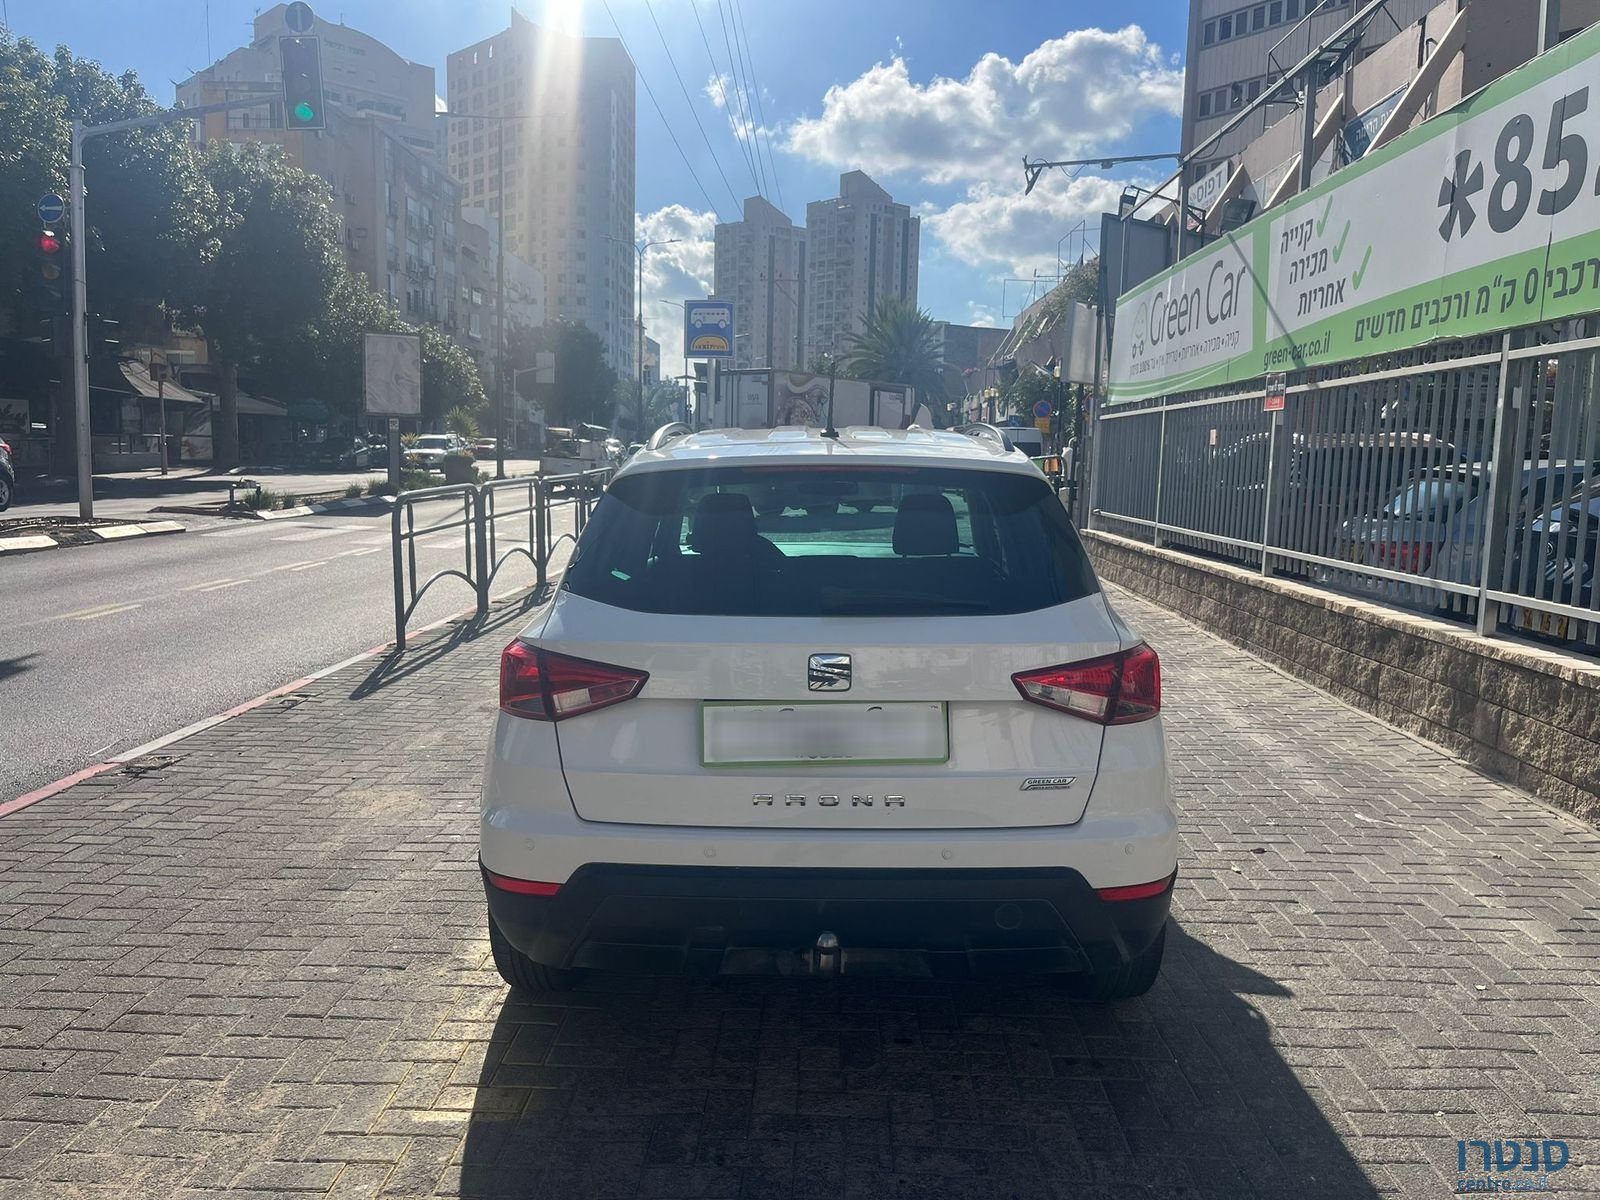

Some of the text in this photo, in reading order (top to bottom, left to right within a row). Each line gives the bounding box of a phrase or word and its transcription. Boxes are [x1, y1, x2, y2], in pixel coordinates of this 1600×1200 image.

[1438, 86, 1600, 243] 85
[1197, 171, 1222, 203] דפוס
[1281, 218, 1314, 255] קנייה
[1289, 248, 1328, 285] מכירה
[1150, 260, 1246, 346] Green Car
[1297, 278, 1347, 317] אחריות
[1523, 267, 1539, 305] 0
[1354, 308, 1406, 343] חדשים
[1410, 290, 1470, 330] ורכבים
[1264, 330, 1331, 371] green-car.co.il
[753, 794, 905, 807] ARONA
